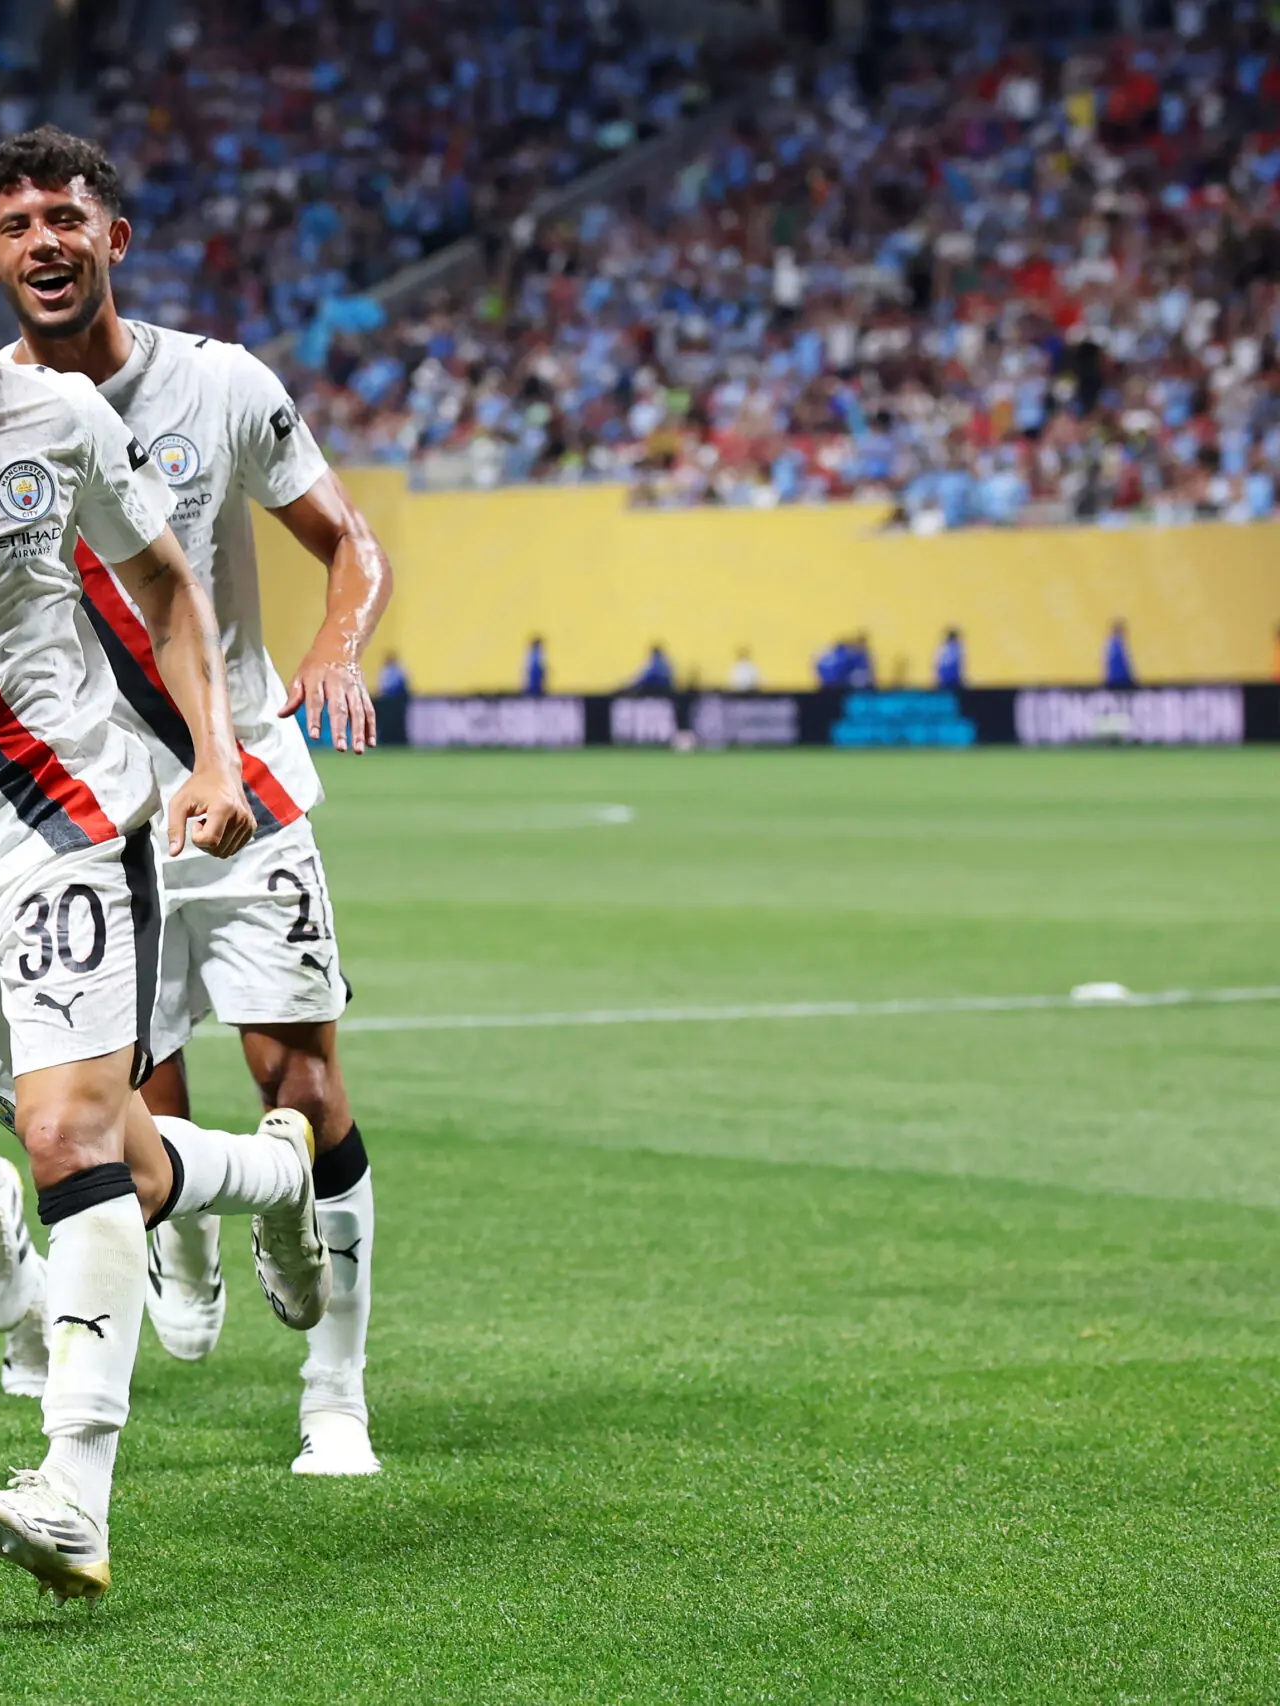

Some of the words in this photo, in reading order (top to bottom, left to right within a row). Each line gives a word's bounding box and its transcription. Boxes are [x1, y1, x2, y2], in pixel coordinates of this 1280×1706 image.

[1, 464, 46, 487] MANCHESTER
[176, 493, 212, 510] HAD
[22, 510, 39, 518] CITY
[11, 545, 51, 560] AIRWAYS
[14, 884, 107, 981] 30
